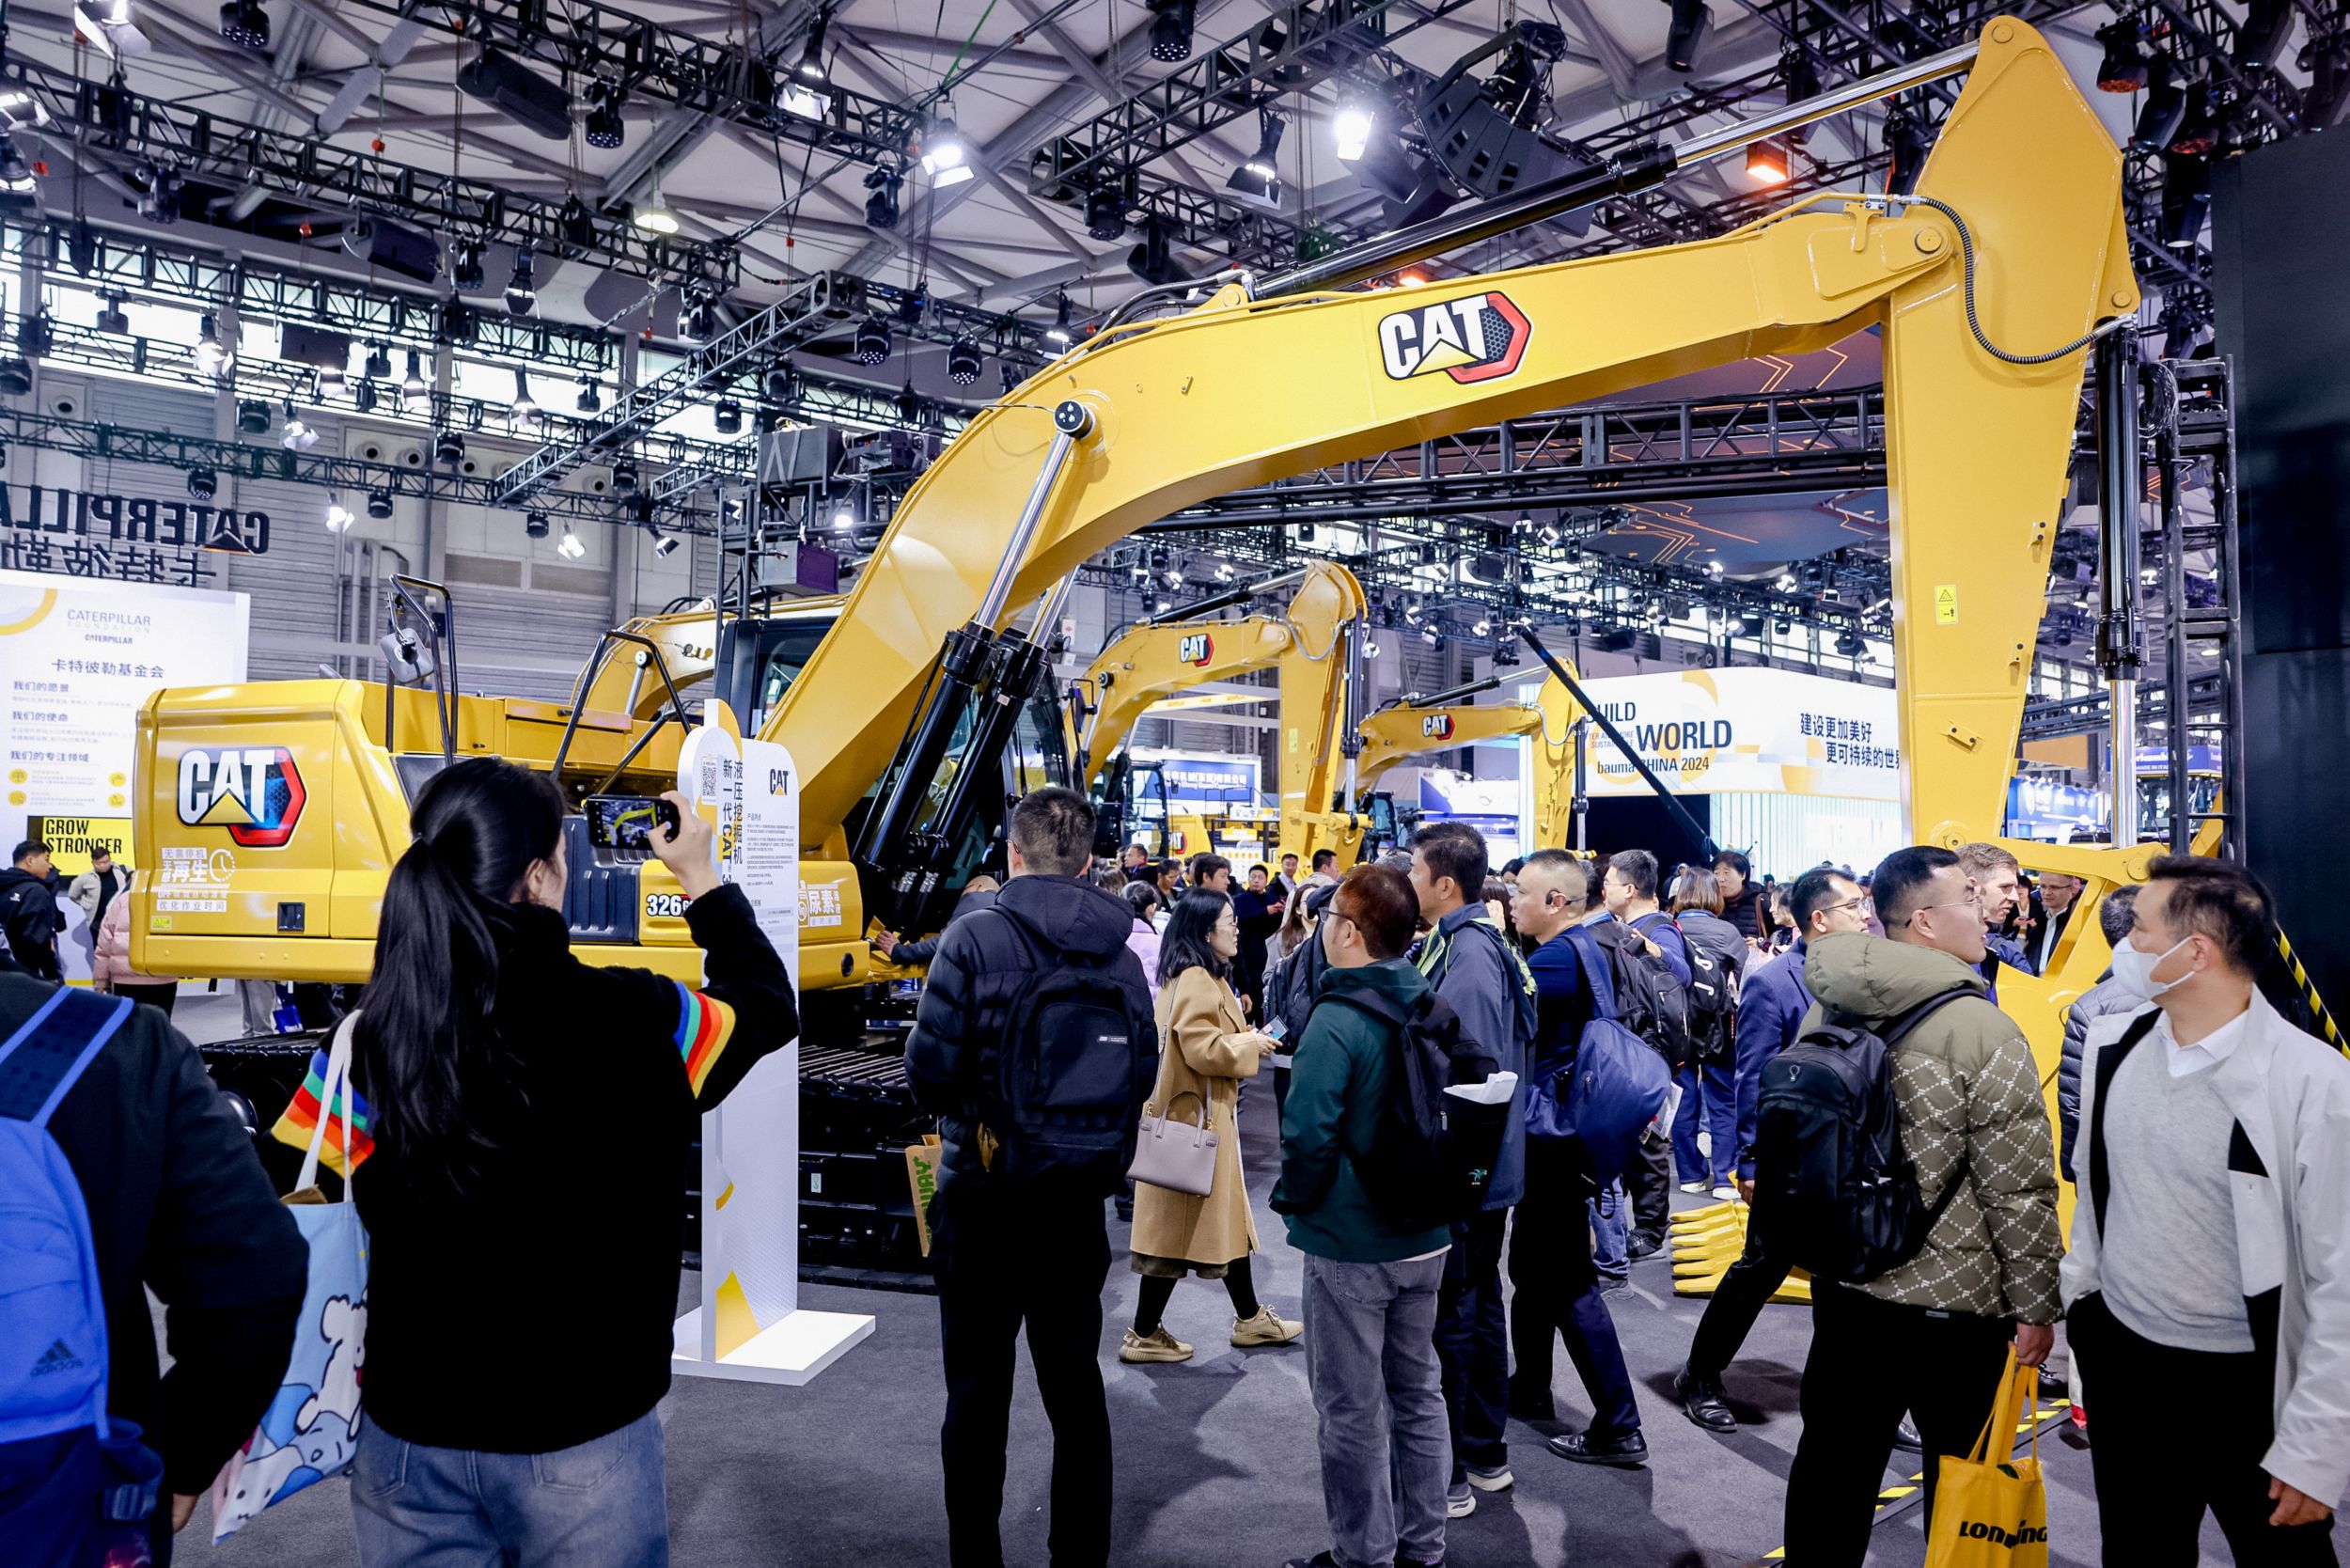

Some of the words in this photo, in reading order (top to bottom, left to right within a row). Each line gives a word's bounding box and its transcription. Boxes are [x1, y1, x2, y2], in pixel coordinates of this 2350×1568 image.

[1380, 294, 1489, 379] CAT
[67, 609, 151, 626] CATERPILLAR
[85, 634, 133, 645] CATERPILLAR
[1180, 635, 1207, 663] CAT
[52, 658, 164, 679] 卡特彼勒基金会
[13, 681, 70, 693] 我们的愿景
[12, 711, 69, 722] 我们的使命
[1587, 702, 1637, 724] UILD
[1422, 714, 1448, 737] CAT
[1636, 720, 1732, 752] WORLD
[1800, 713, 1872, 743] 建设更加美好
[10, 750, 89, 762] 我们的专注领域
[1597, 760, 1635, 775] bauma
[1681, 756, 1710, 772] 2024
[180, 749, 275, 824] CAT
[770, 768, 790, 796] CAT
[733, 760, 744, 865] 液压挖掘机
[45, 819, 89, 836] GROW
[159, 901, 226, 911] 优化作业时间
[647, 894, 682, 917] 326
[30, 1359, 84, 1377] adidas
